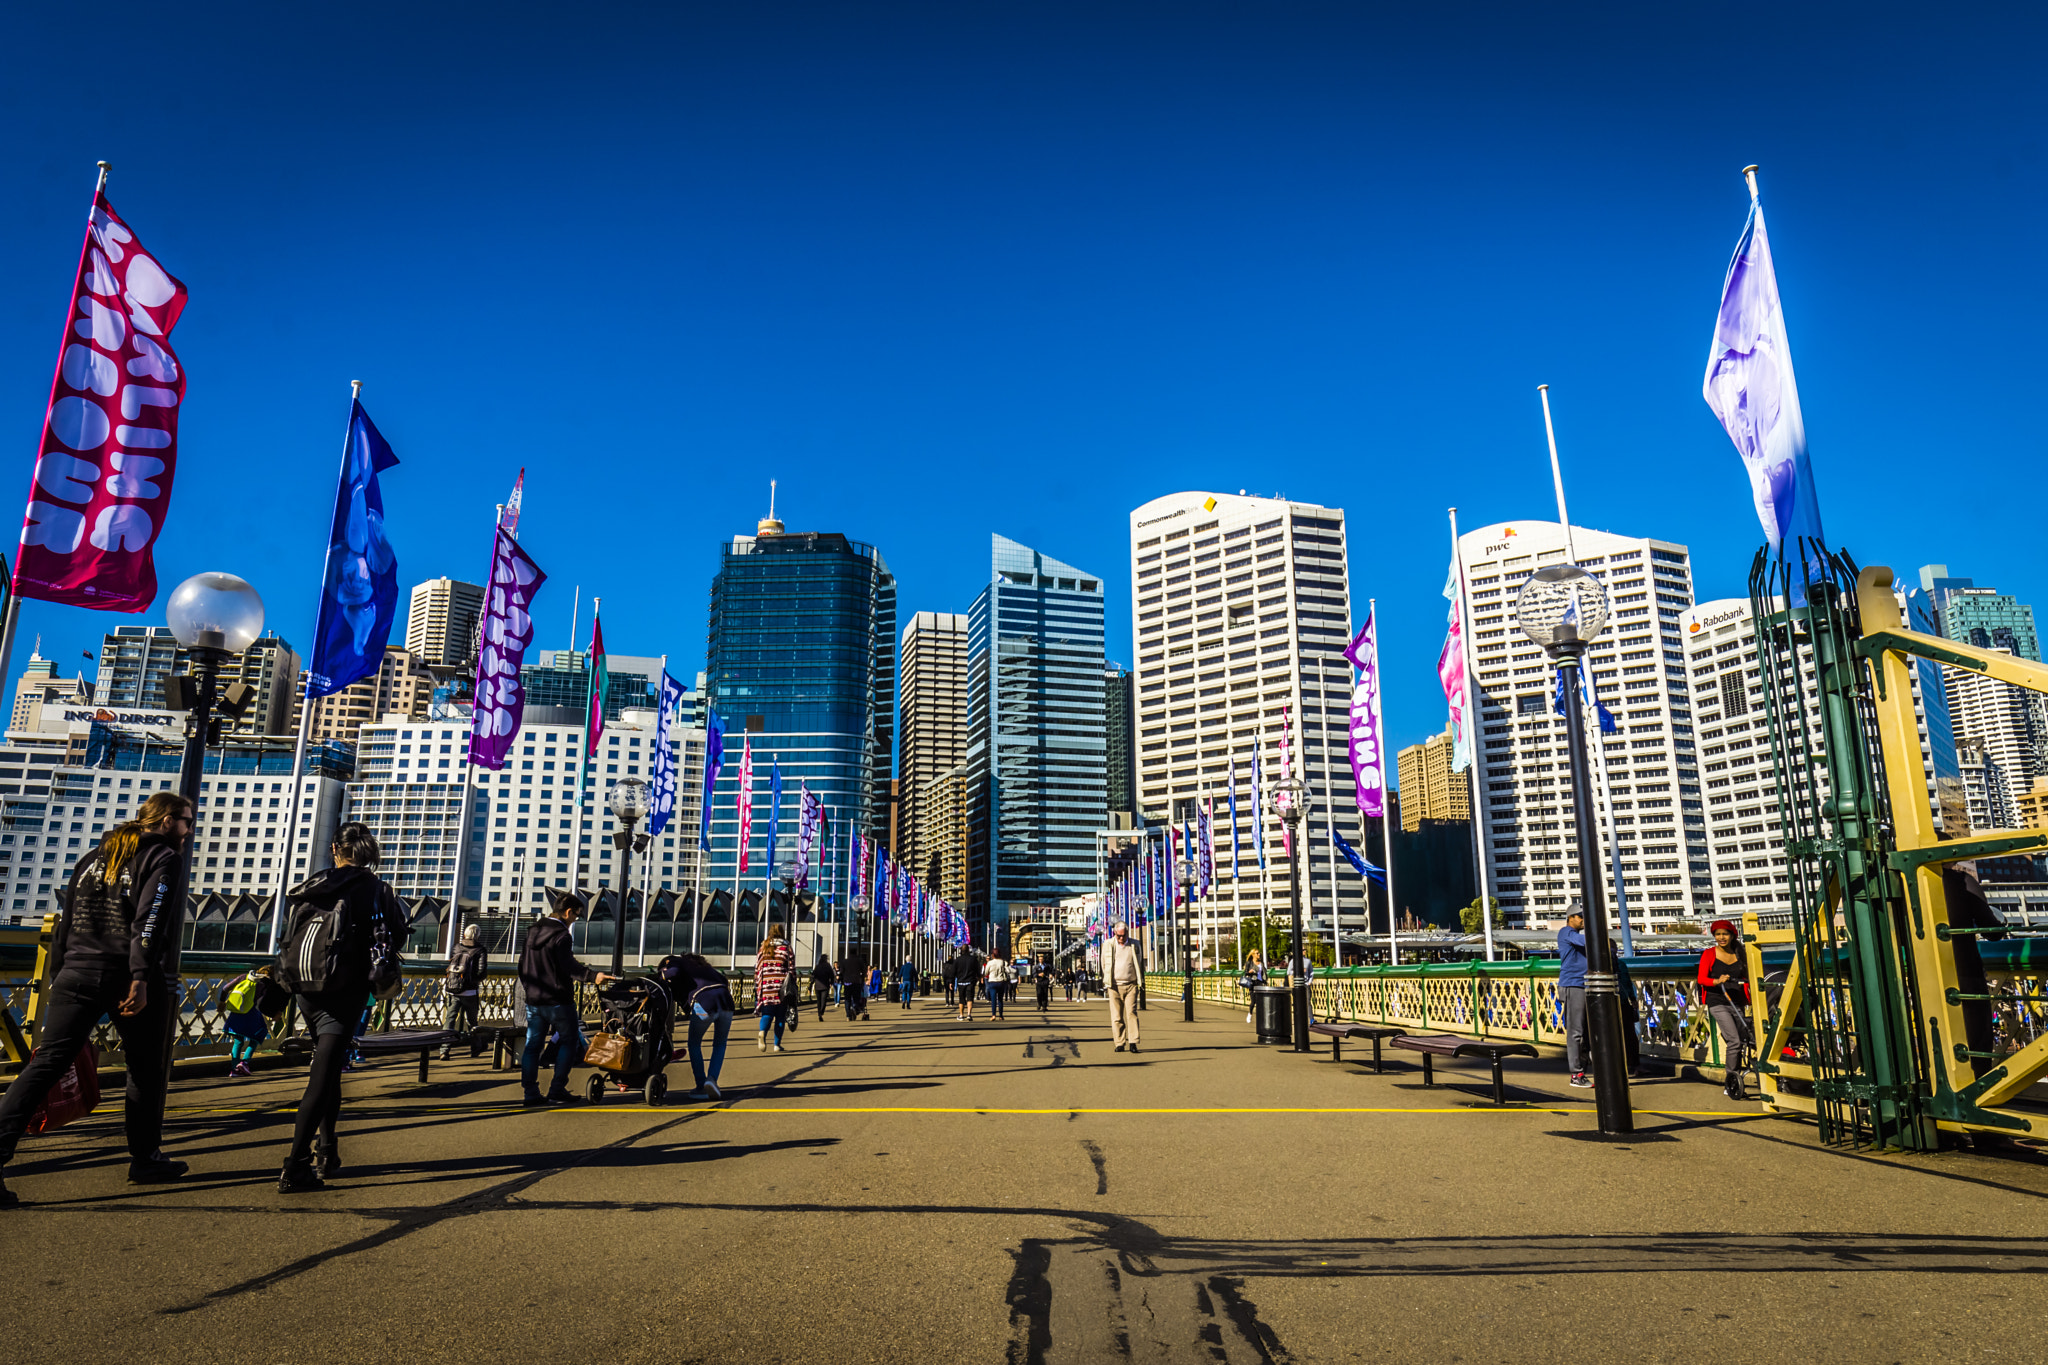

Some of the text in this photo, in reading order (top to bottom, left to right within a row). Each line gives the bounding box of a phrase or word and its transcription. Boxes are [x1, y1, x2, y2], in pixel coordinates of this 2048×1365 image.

[20, 205, 132, 554] HARBOUR
[90, 254, 177, 552] DARLING
[1485, 542, 1510, 555] pwc
[1703, 606, 1745, 628] Rabobank
[63, 710, 176, 726] ING DIRECT
